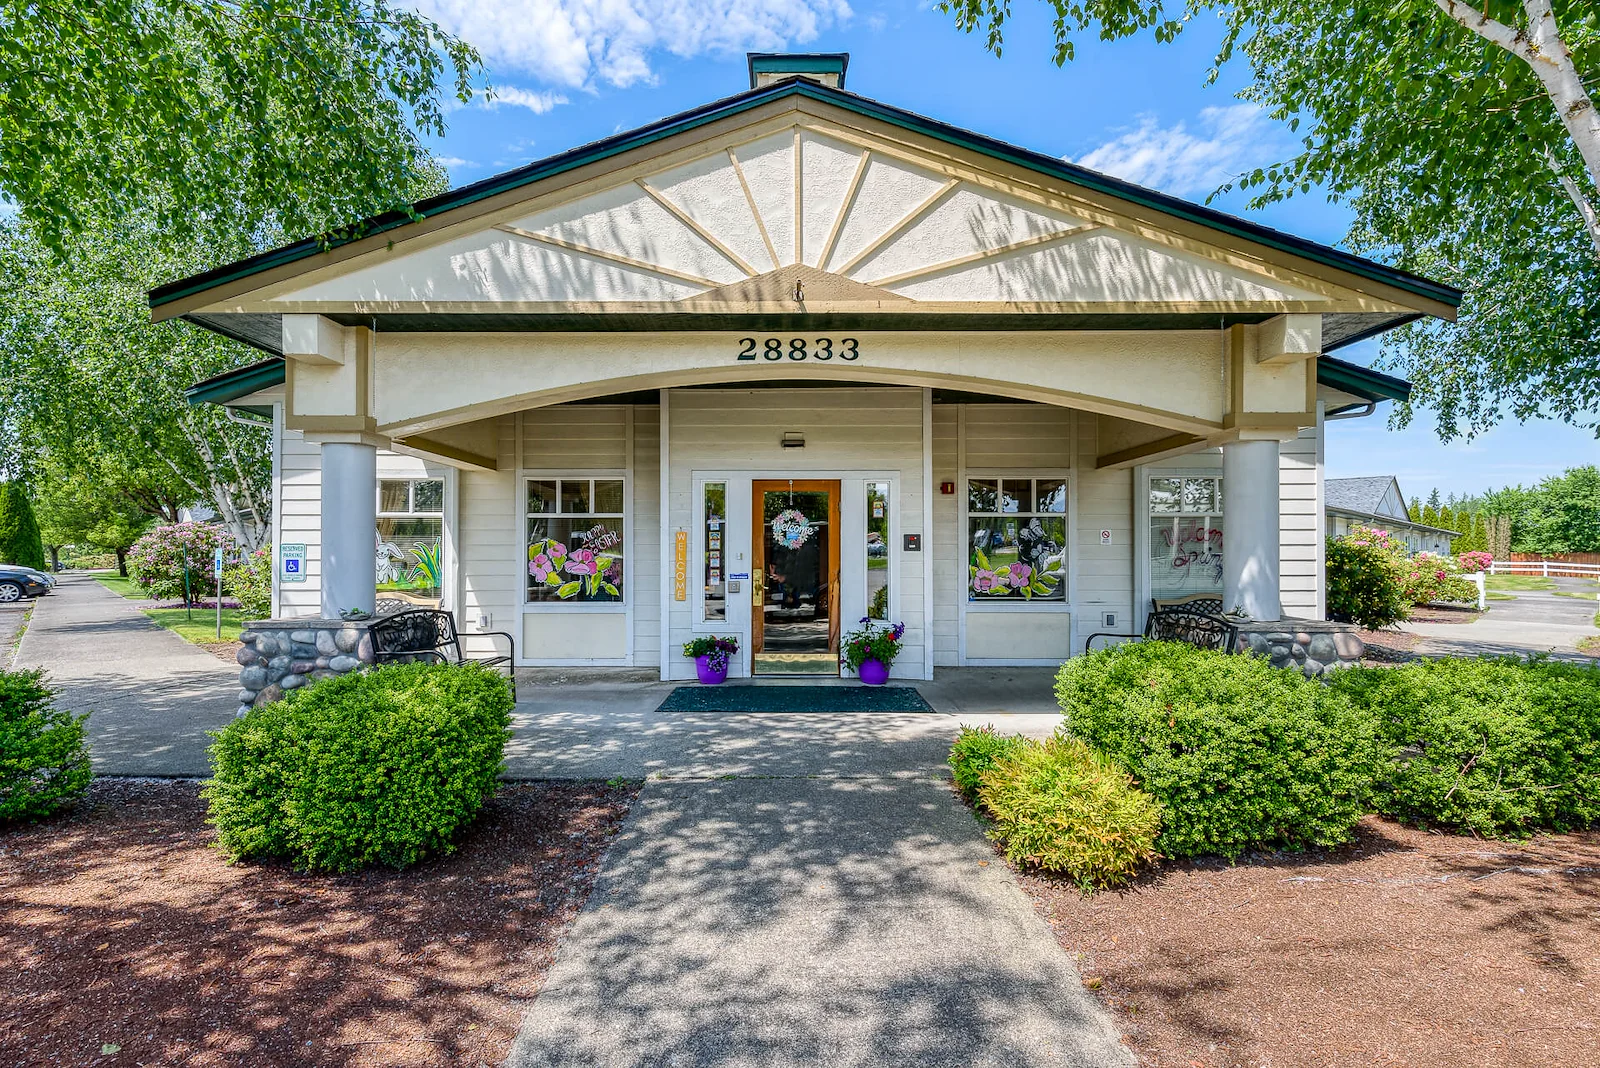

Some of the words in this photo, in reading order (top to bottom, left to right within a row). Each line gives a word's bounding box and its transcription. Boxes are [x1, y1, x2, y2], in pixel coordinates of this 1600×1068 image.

[737, 337, 860, 361] 28833
[771, 520, 815, 536] Welcome
[1160, 519, 1223, 549] Welcom
[676, 533, 686, 599] WELCOME
